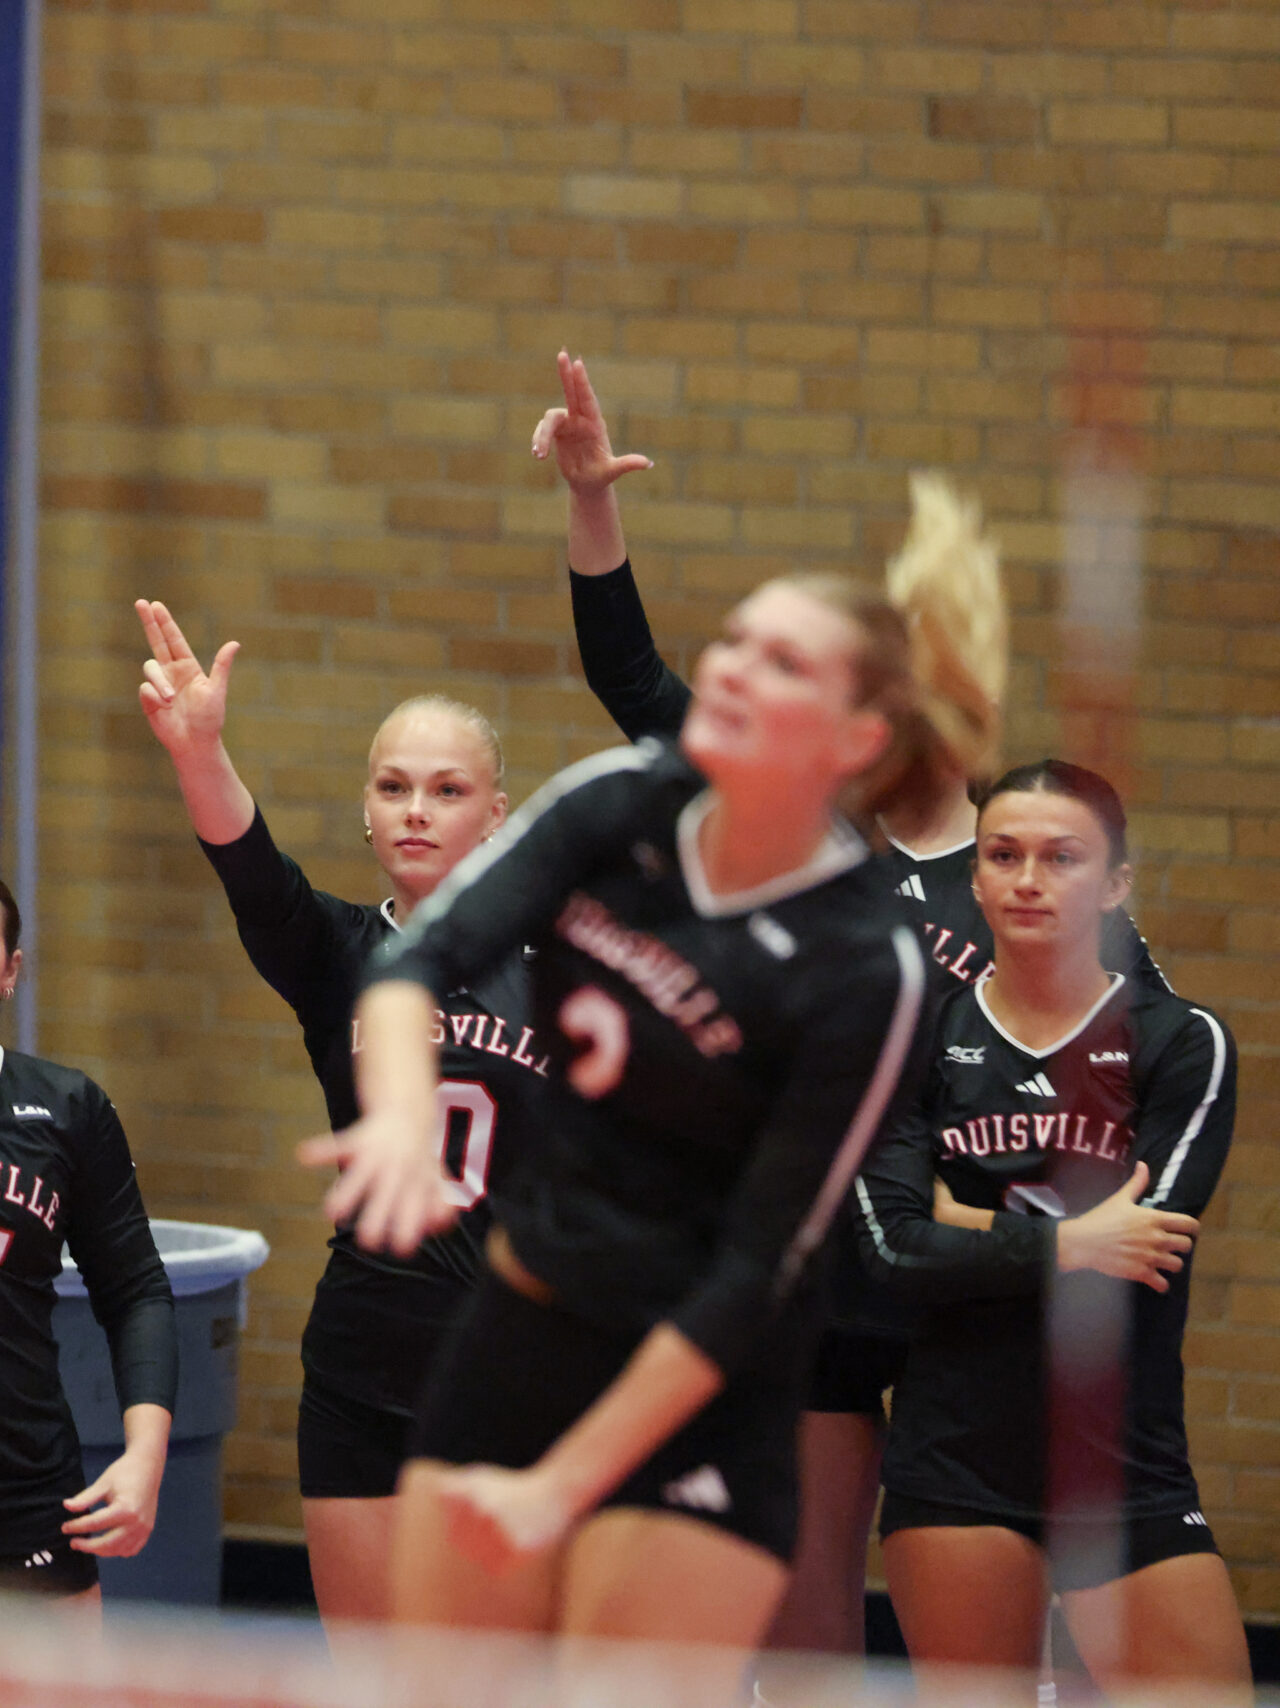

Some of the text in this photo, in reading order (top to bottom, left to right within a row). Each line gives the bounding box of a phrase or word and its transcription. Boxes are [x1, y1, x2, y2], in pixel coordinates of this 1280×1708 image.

[350, 1008, 551, 1078] LSVILL
[1089, 1051, 1129, 1063] L&N
[940, 1112, 1137, 1166] OUISVILL
